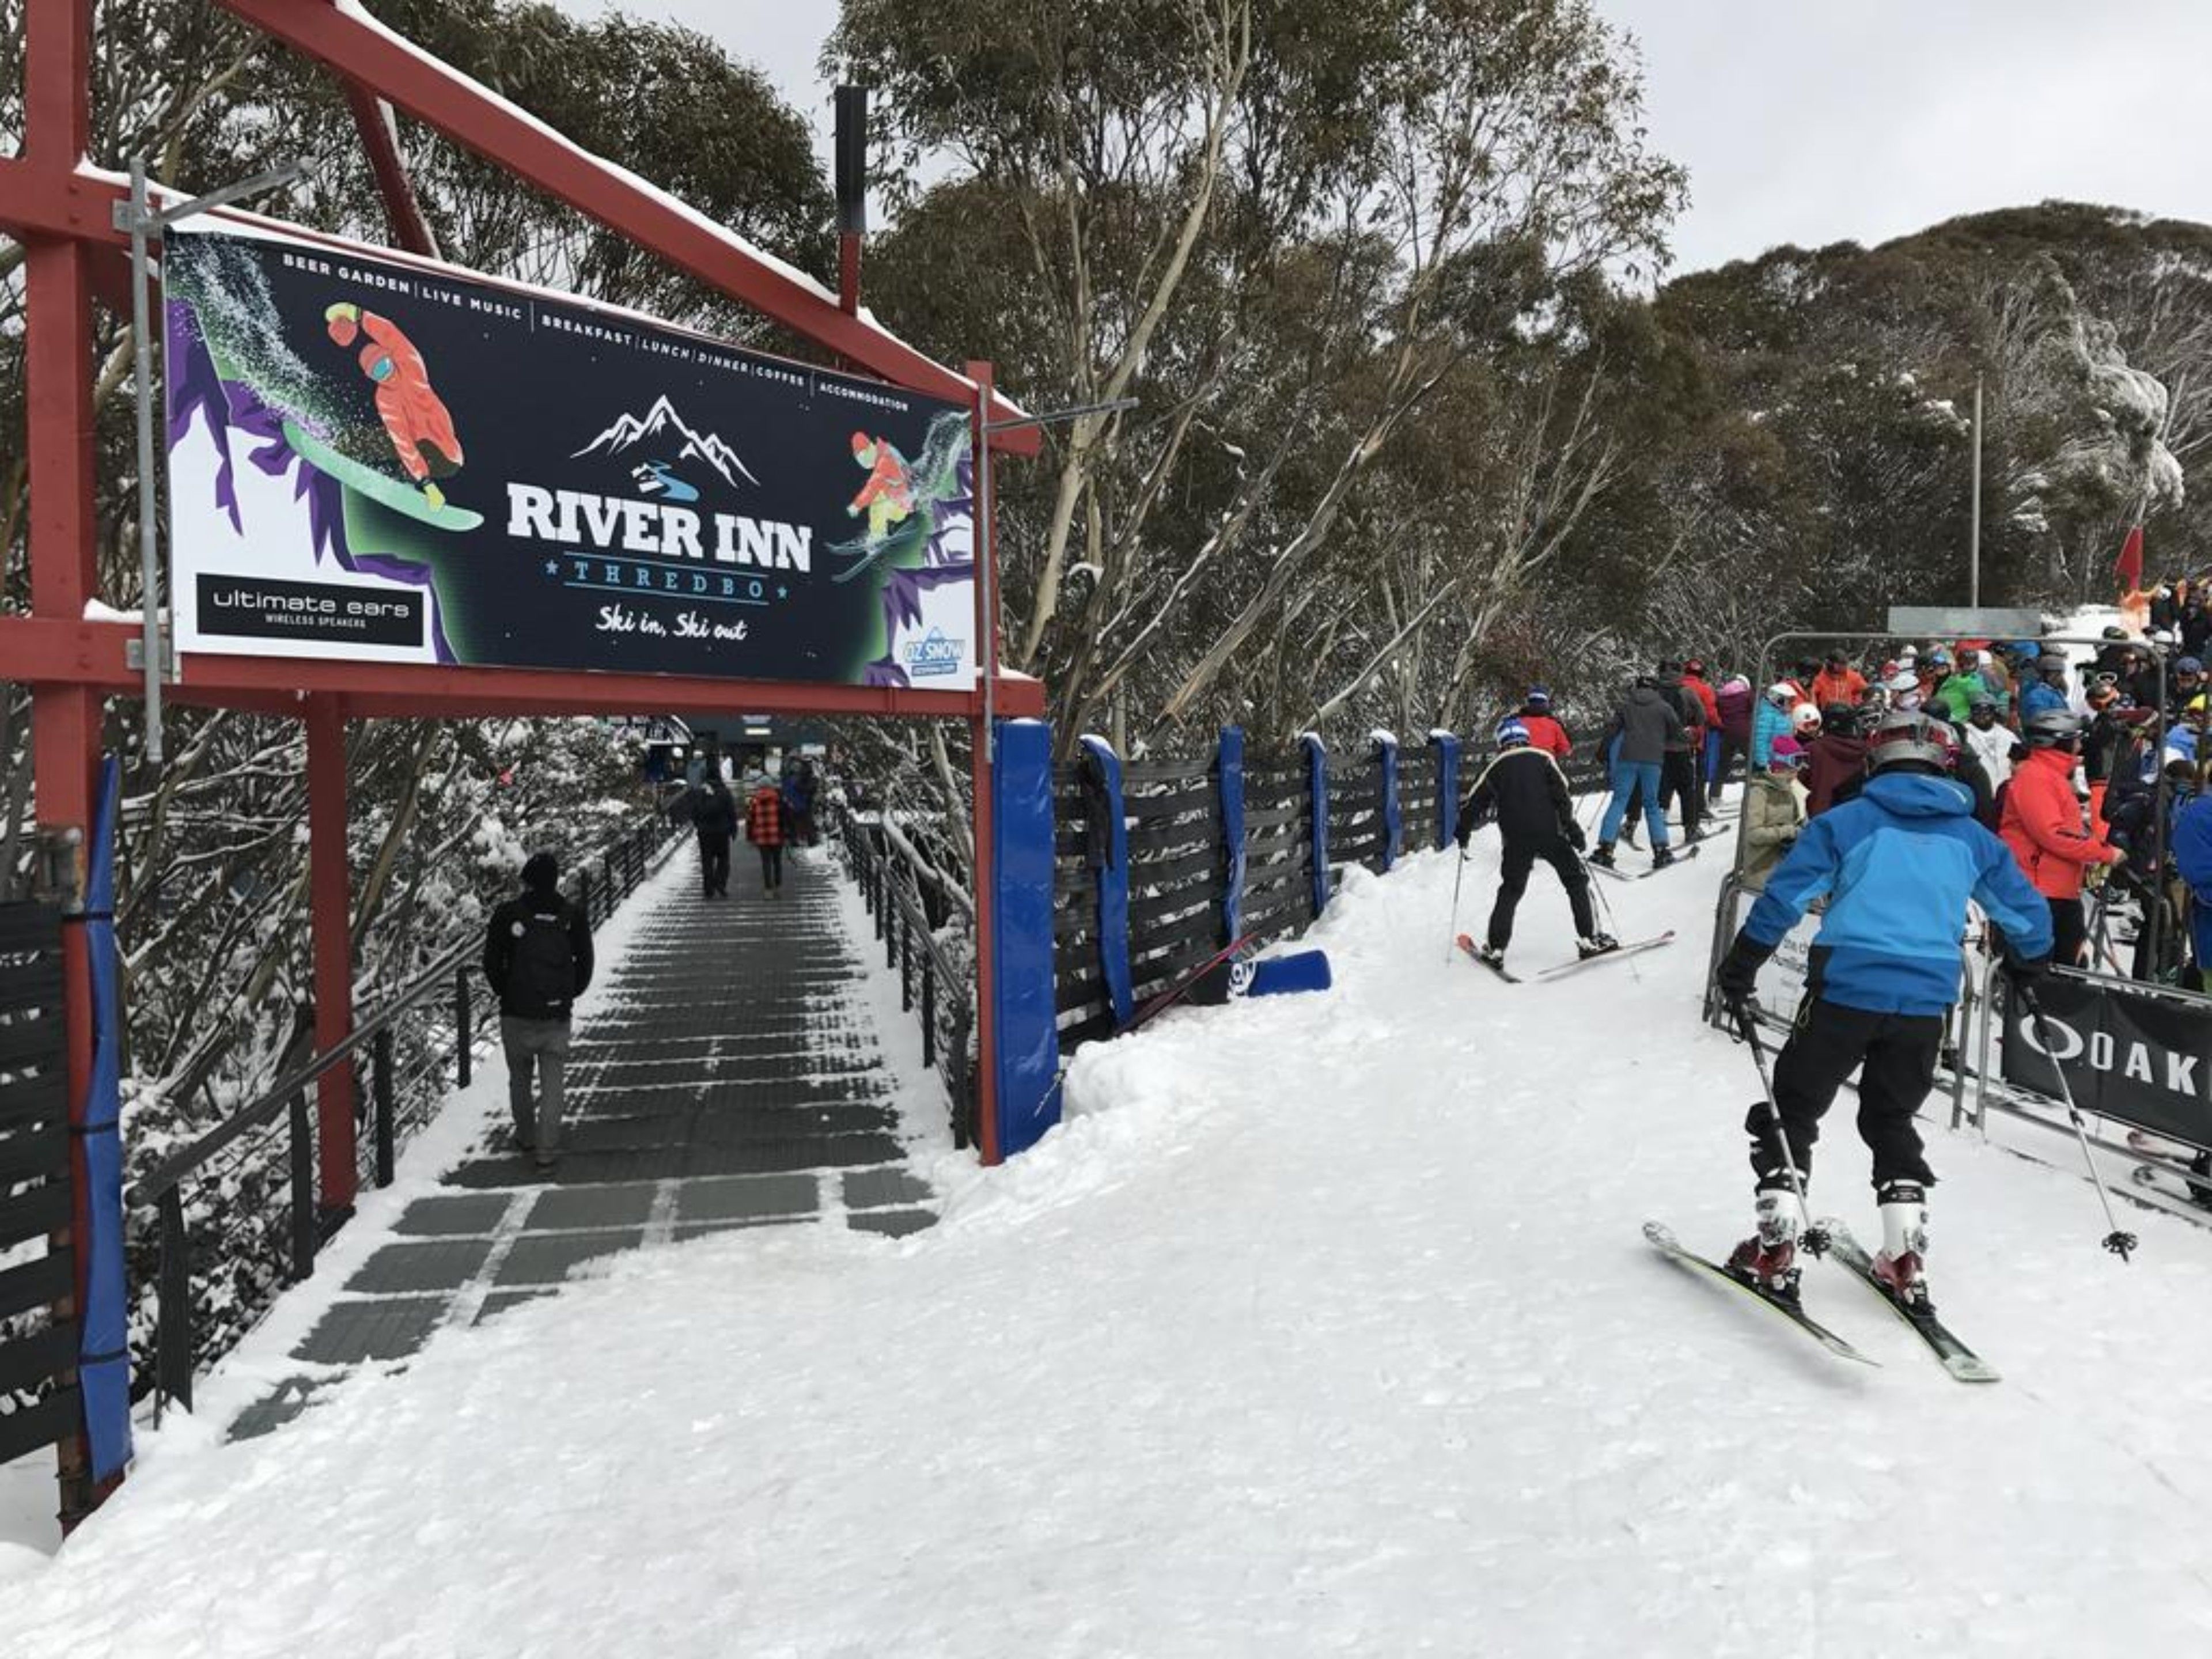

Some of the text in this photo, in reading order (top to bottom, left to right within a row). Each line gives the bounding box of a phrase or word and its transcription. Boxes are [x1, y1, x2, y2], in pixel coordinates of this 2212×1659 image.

[283, 253, 908, 411] BEER GARDEN LIVE MUSIC BREAKFAST LUNCH DINNER COFFEE ACCOMMODATION
[507, 483, 812, 573] RIVER INN
[574, 561, 764, 597] THREDBO
[213, 589, 410, 618] ultimate ears
[265, 613, 366, 629] WIRELESS SPEAKERS
[595, 604, 748, 641] Ski in, Ski out
[2090, 1031, 2212, 1101] OAK
